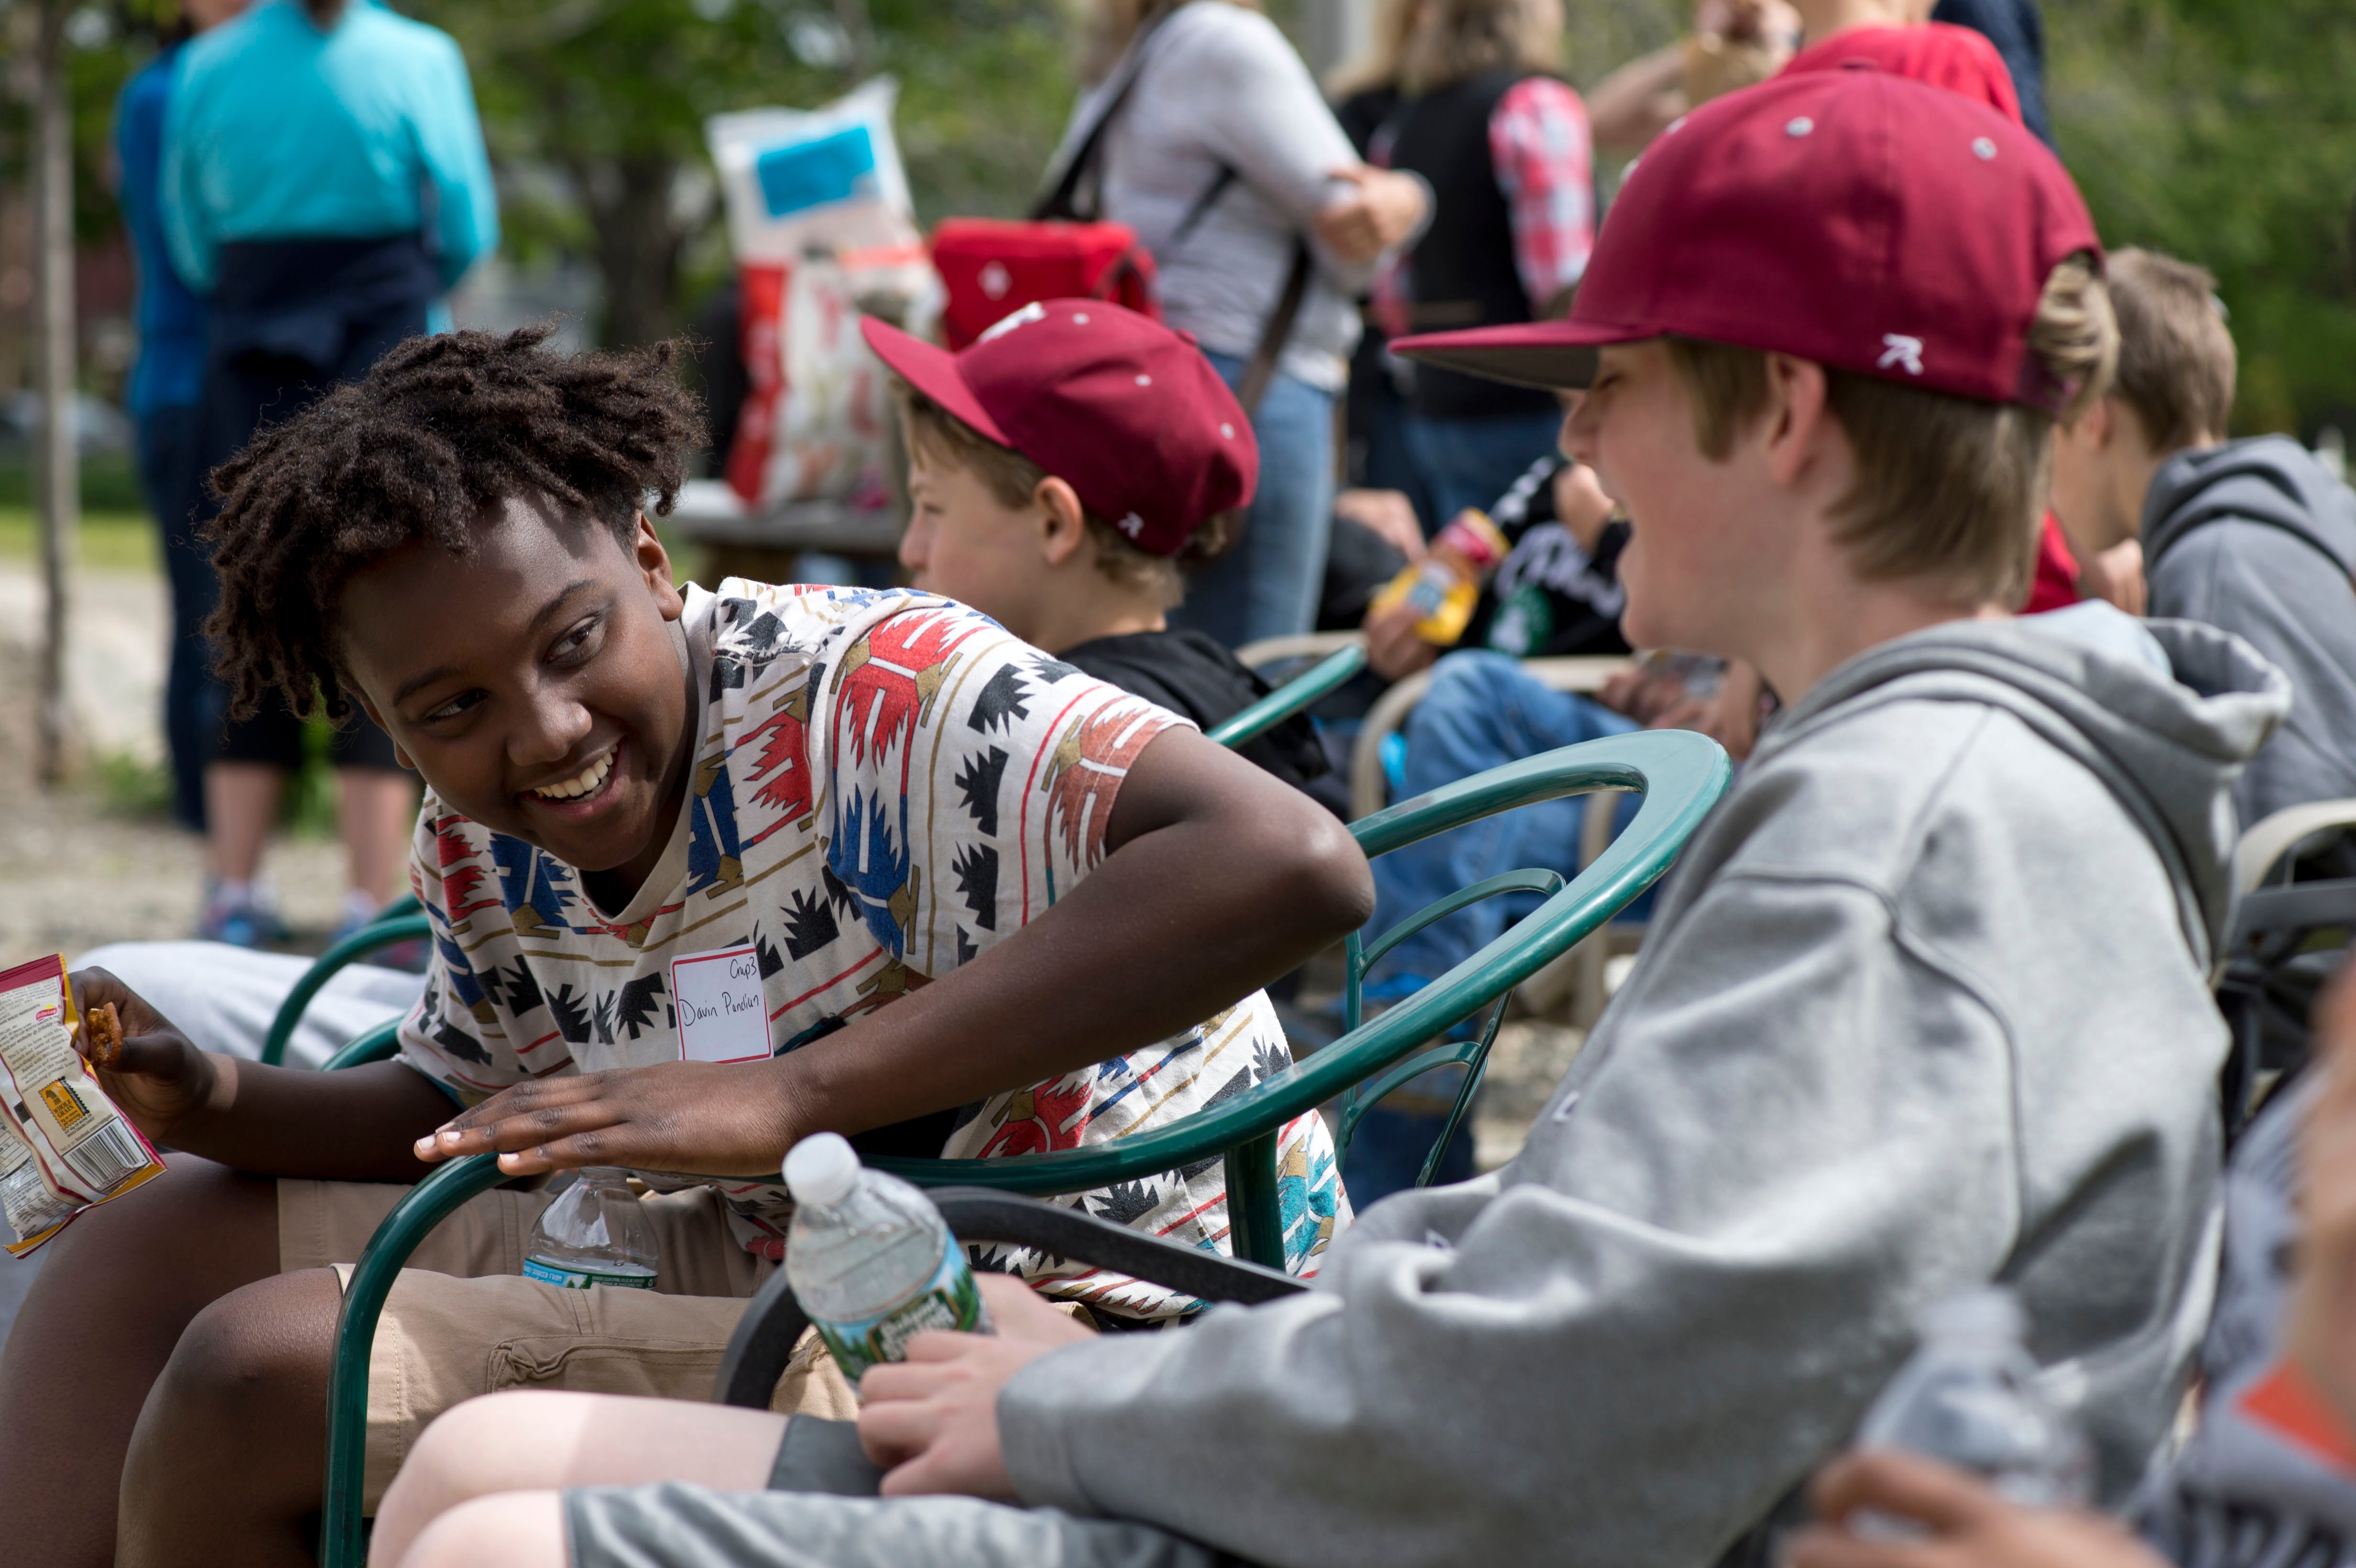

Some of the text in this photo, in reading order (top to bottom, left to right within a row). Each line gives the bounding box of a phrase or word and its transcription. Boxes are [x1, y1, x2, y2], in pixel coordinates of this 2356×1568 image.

[42, 1030, 54, 1039] with
[52, 1098, 72, 1114] WHOLE
[56, 1103, 75, 1118] GRAIN
[548, 1273, 563, 1282] FROM
